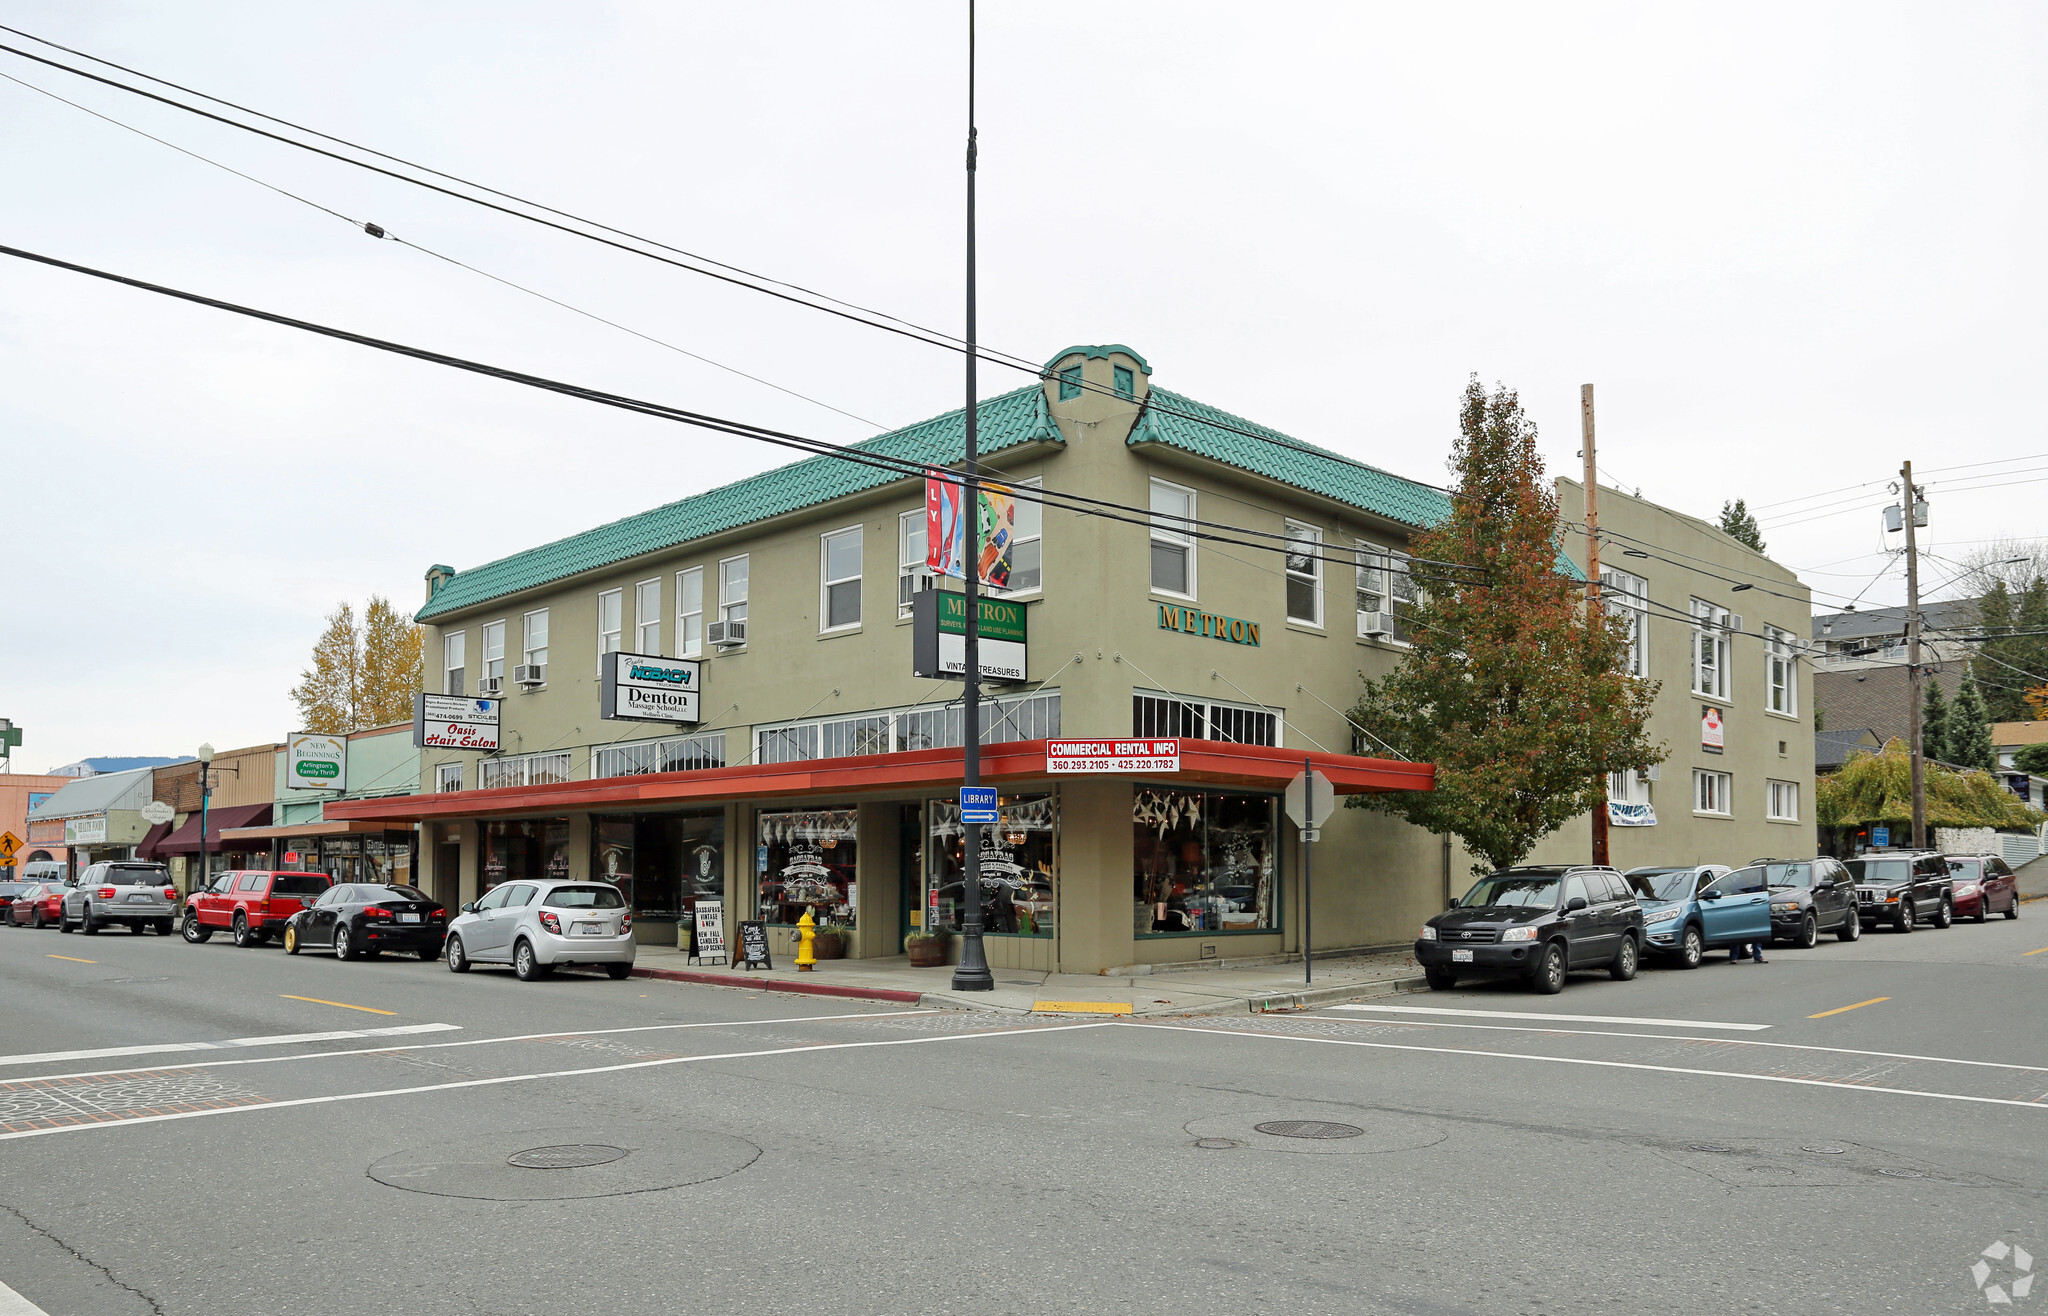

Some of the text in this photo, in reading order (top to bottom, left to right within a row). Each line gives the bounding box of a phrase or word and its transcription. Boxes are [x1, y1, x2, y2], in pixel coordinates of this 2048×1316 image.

[947, 598, 1017, 623] MTRON
[980, 625, 993, 633] LAND
[1003, 628, 1024, 637] PLANNING
[1160, 605, 1260, 645] METRON
[629, 665, 692, 685] NOBACH
[946, 661, 1020, 677] VINTA TREASURES
[628, 688, 688, 706] Denton
[628, 701, 655, 711] Massage
[447, 723, 477, 736] Oasis
[426, 734, 497, 748] Hair Salon
[296, 749, 341, 760] BEGINNINGS
[1050, 742, 1175, 756] COMMERCIAL RENTAL INFO
[302, 762, 334, 770] Arlington's
[1052, 759, 1174, 770] 360.293.2105 425.220.1782
[300, 768, 319, 776] Family
[963, 794, 994, 804] LIBRARY
[77, 820, 92, 833] HEALTH
[92, 819, 105, 832] FOODS
[366, 839, 386, 850] Games
[695, 906, 720, 914] SASSAFRAS
[699, 937, 719, 945] CANDLES
